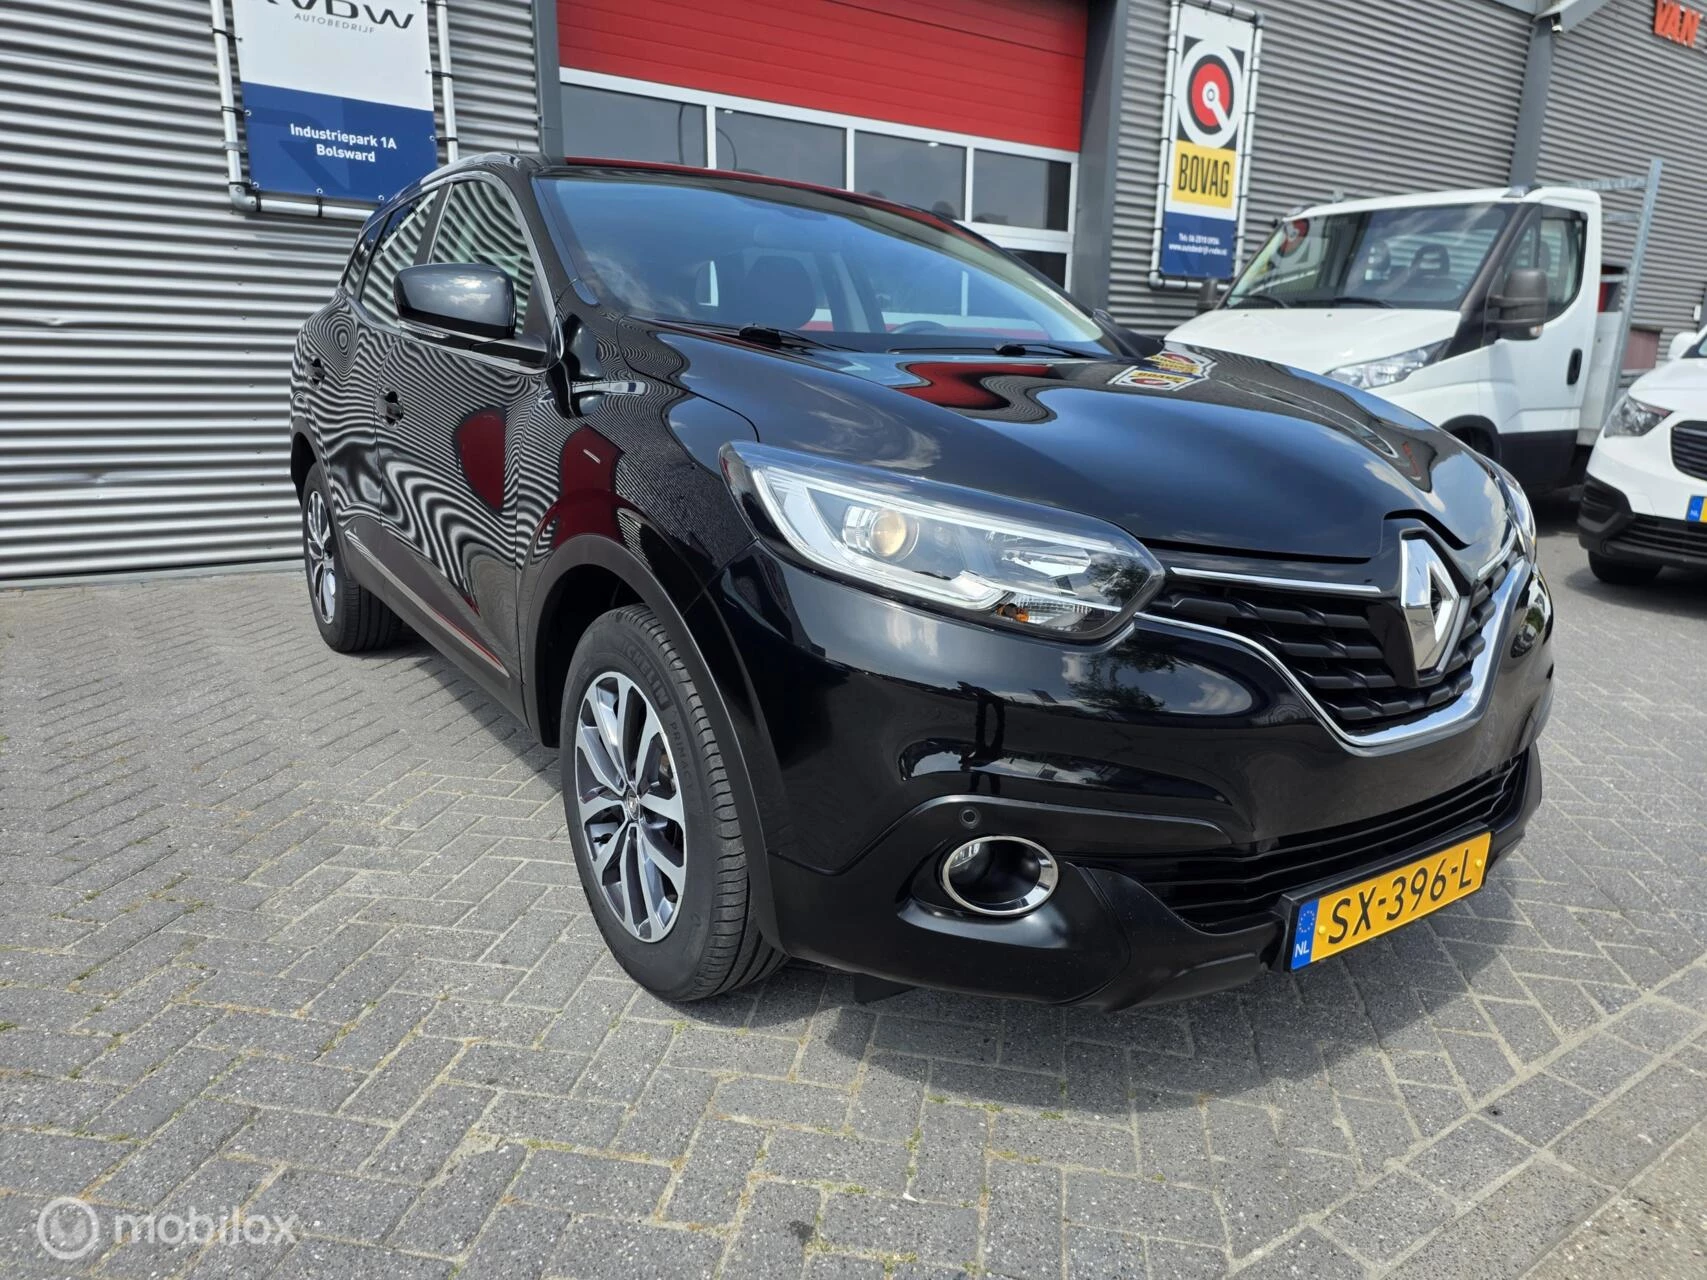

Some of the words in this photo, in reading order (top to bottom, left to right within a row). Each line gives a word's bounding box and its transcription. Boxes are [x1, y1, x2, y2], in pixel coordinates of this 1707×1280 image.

[294, 13, 375, 34] AUTOBEDRIJF
[1654, 0, 1703, 48] VAN
[290, 123, 378, 147] Industriepark
[380, 136, 397, 149] 1A
[316, 144, 376, 162] Bolsward
[1178, 153, 1230, 198] BOVAG
[1328, 849, 1472, 944] SX-396-L
[1294, 940, 1310, 958] NL
